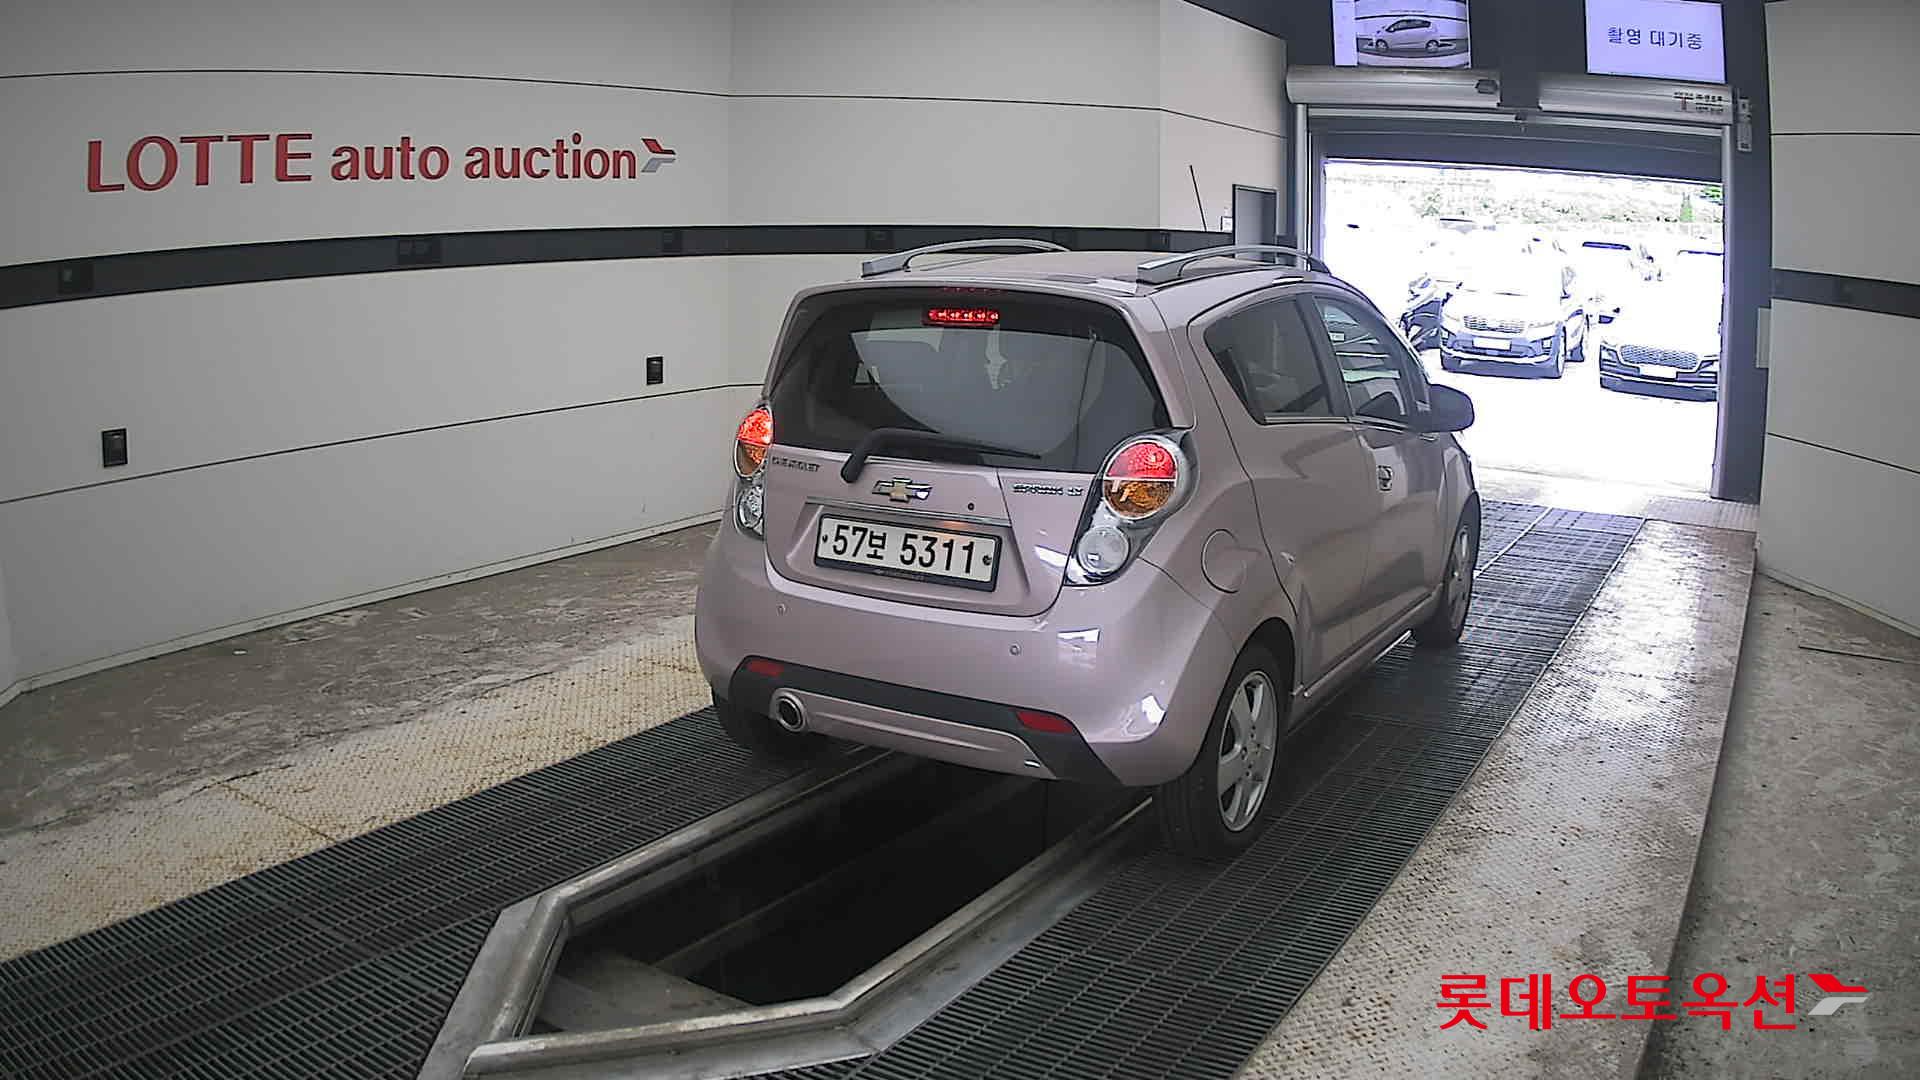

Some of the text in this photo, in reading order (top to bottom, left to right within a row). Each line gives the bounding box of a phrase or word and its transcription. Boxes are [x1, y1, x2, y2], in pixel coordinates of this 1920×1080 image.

[1608, 27, 1702, 50] 촬영 대기중
[87, 132, 637, 192] LOTTE auto auction
[832, 524, 975, 574] 57보 5311
